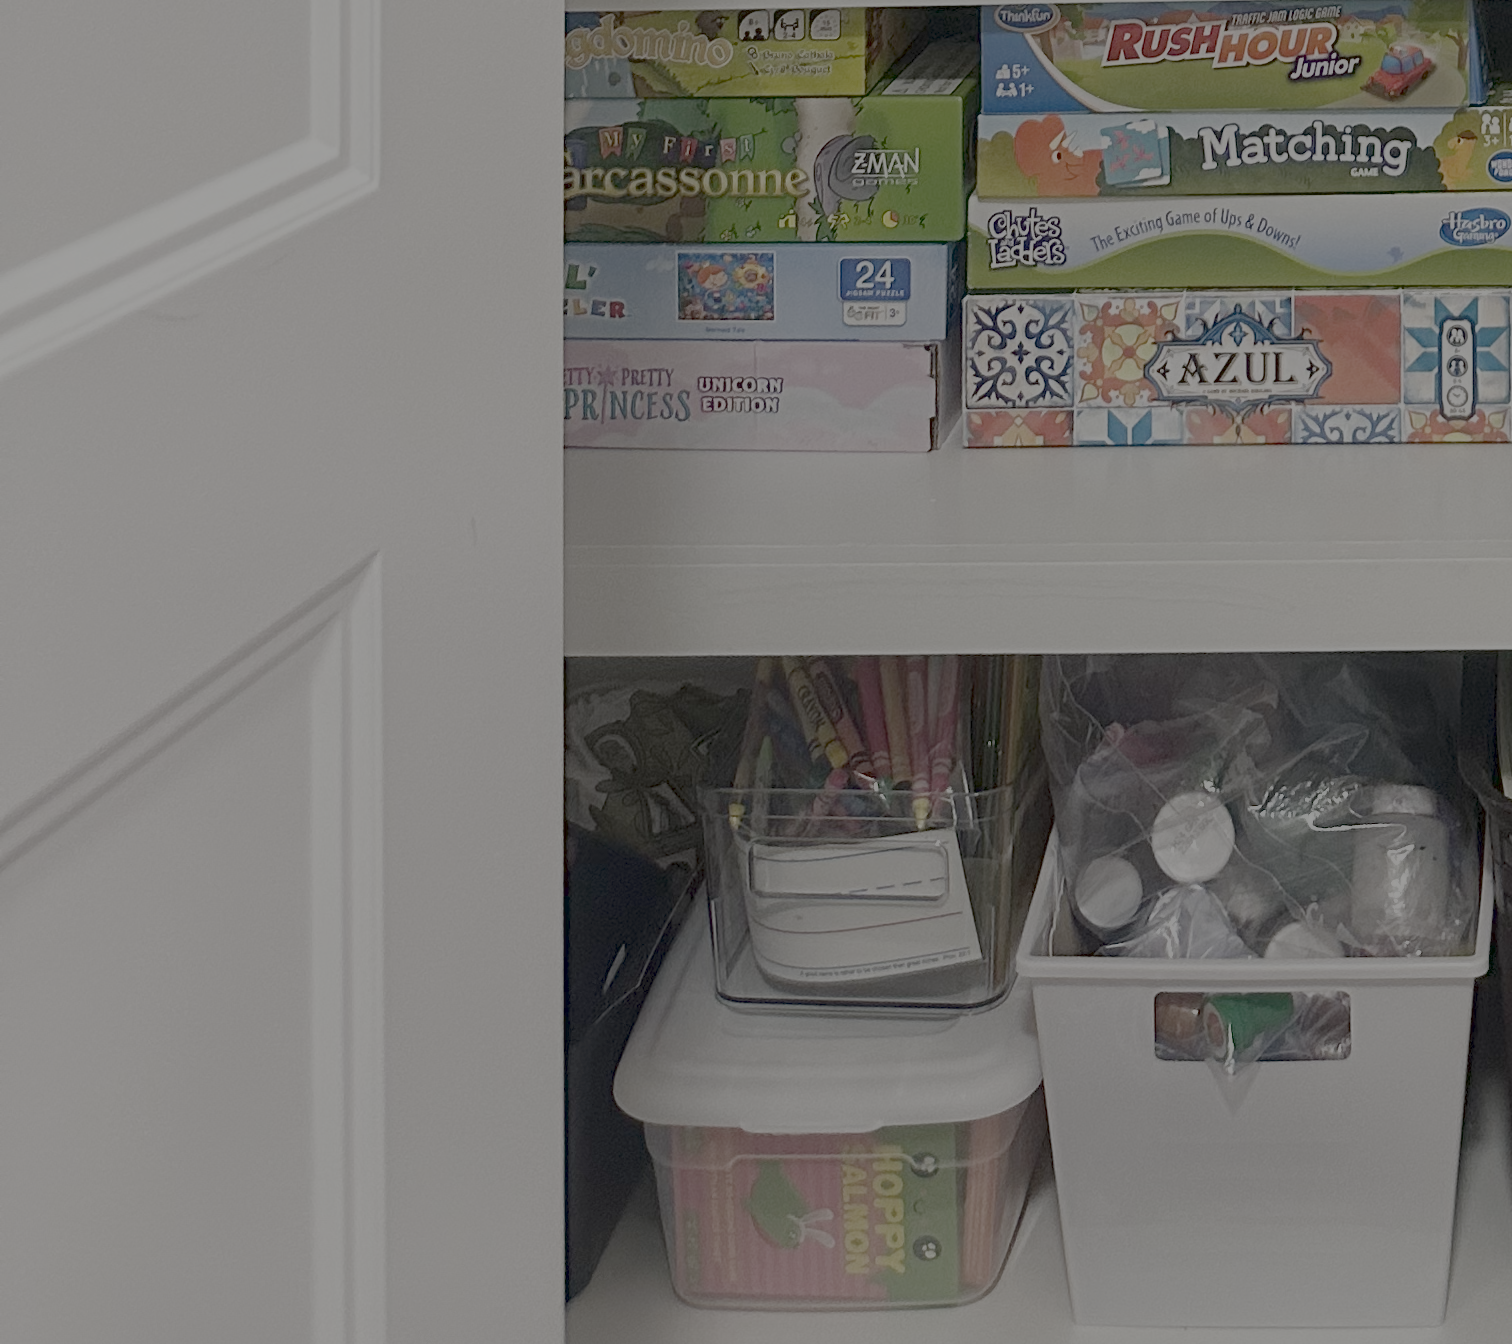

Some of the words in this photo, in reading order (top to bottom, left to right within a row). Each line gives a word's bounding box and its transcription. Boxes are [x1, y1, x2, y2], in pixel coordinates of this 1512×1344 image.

[1106, 21, 1227, 63] RUSH
[1216, 26, 1335, 65] HOUR
[1290, 55, 1361, 80] Junior
[604, 130, 643, 151] My
[662, 134, 751, 158] First
[1199, 120, 1413, 177] Matching
[563, 165, 810, 201] arcassonne
[987, 207, 1061, 240] Chutes
[1089, 235, 1116, 253] The
[1114, 217, 1164, 243] Exciting
[1165, 209, 1201, 227] Game
[1203, 207, 1219, 224] of
[1220, 208, 1242, 230] Ups
[1244, 213, 1255, 230] &
[1256, 217, 1302, 250] Downs!
[1440, 211, 1507, 231] Hasbro
[987, 236, 1067, 269] Ladders
[854, 260, 896, 289] 24
[697, 376, 784, 394] UNICORN
[1177, 352, 1300, 386] AZUL
[700, 396, 780, 414] EDITION
[872, 1145, 906, 1274] HOPPY
